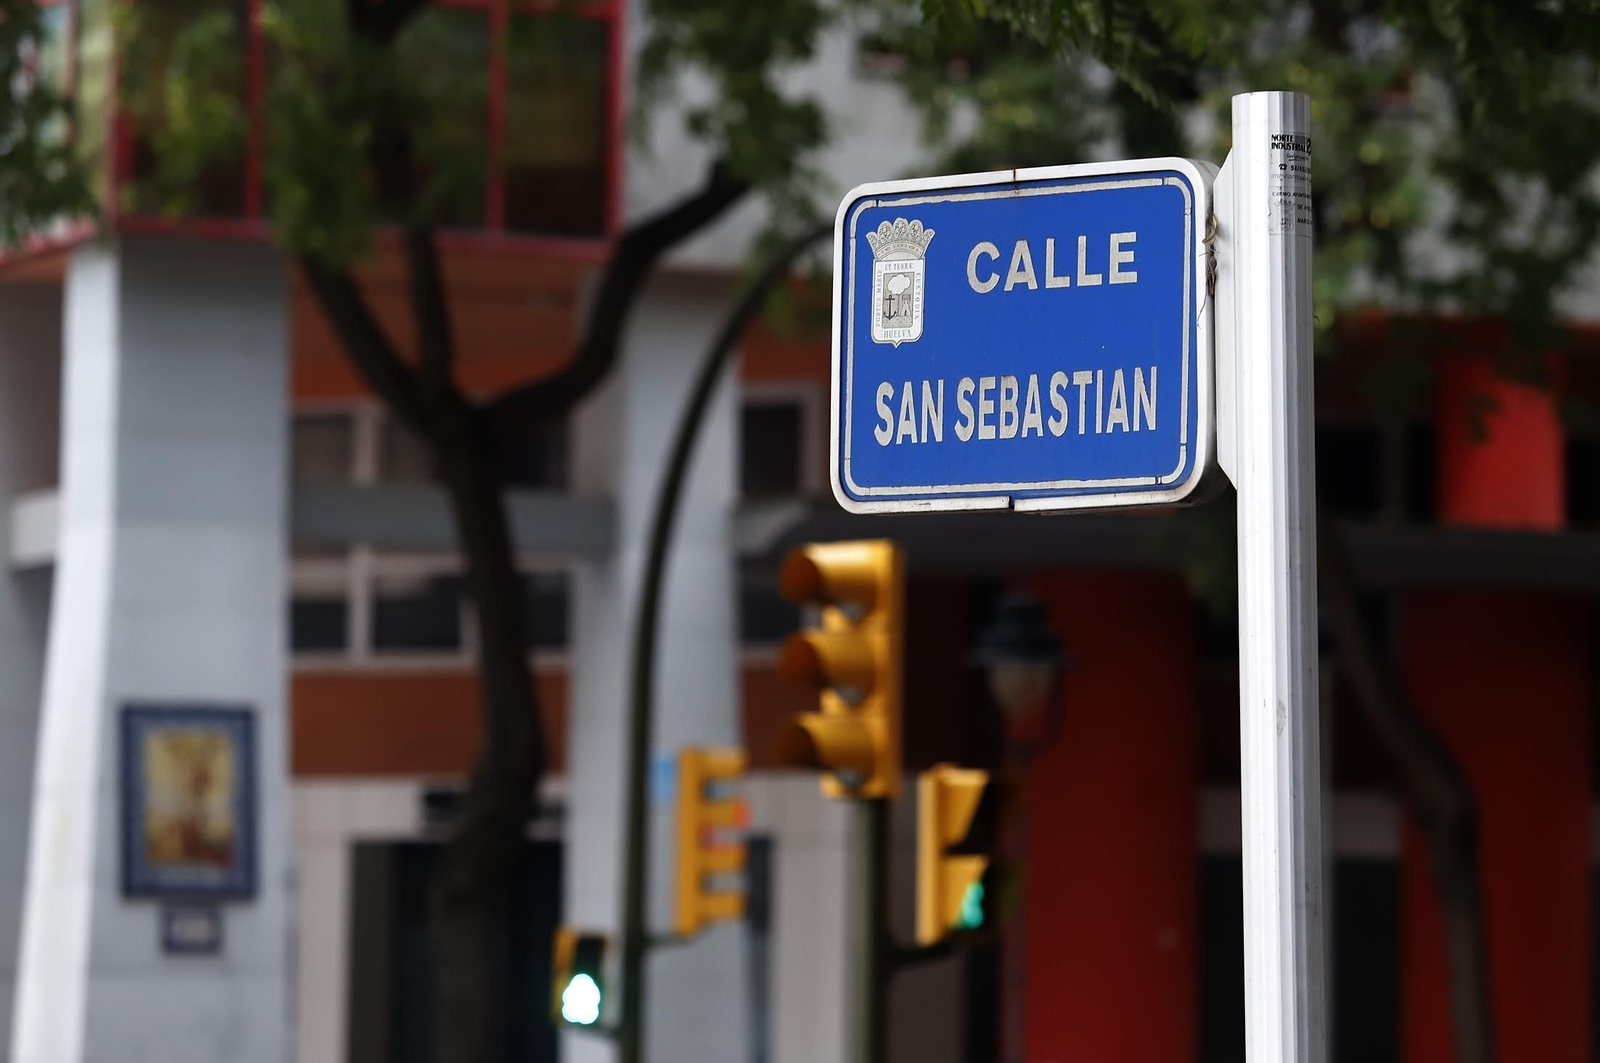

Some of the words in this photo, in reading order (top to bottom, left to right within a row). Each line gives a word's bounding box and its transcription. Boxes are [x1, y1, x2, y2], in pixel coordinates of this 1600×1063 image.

[1271, 133, 1294, 142] NORTE
[966, 231, 1138, 294] CALLE
[883, 329, 912, 339] HUELVA
[873, 379, 945, 447] SAN
[953, 365, 1158, 443] SEBASTIAN
